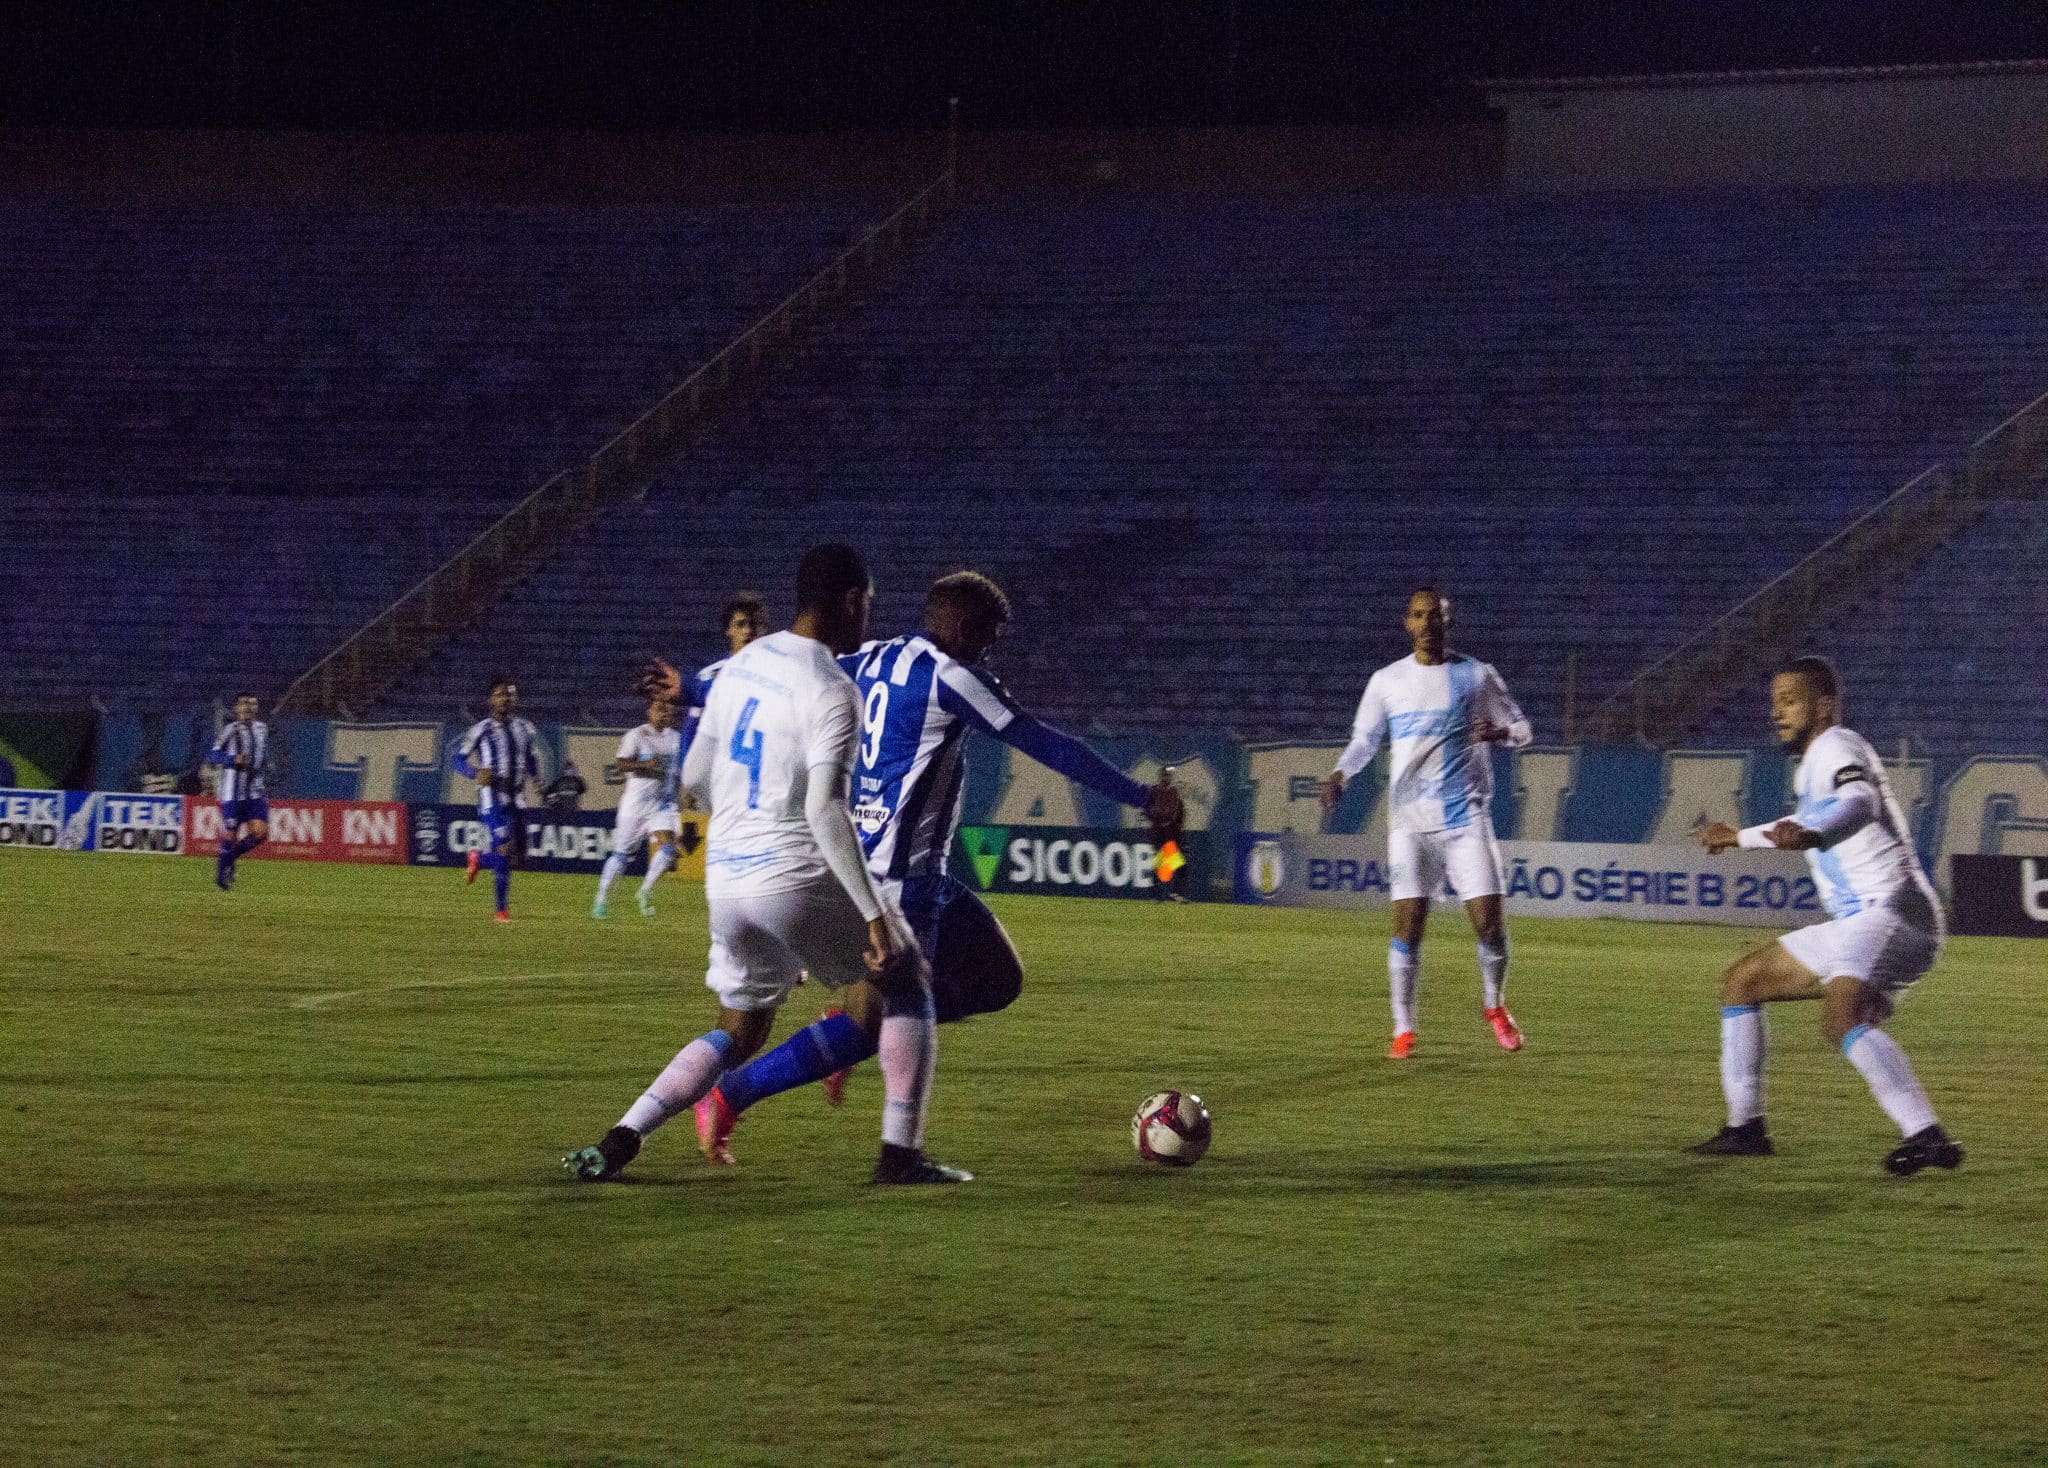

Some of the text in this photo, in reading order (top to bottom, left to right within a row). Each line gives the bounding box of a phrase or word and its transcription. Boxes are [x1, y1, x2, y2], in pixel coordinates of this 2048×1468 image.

[862, 681, 889, 770] 9
[730, 697, 764, 809] 4
[0, 796, 57, 821] EK
[105, 800, 177, 827] TEK
[0, 823, 56, 846] OND
[102, 828, 178, 852] BOND
[448, 820, 492, 854] CB
[1573, 861, 1688, 905] SÉRIE
[1696, 872, 1724, 907] B
[1735, 875, 1819, 911] 202
